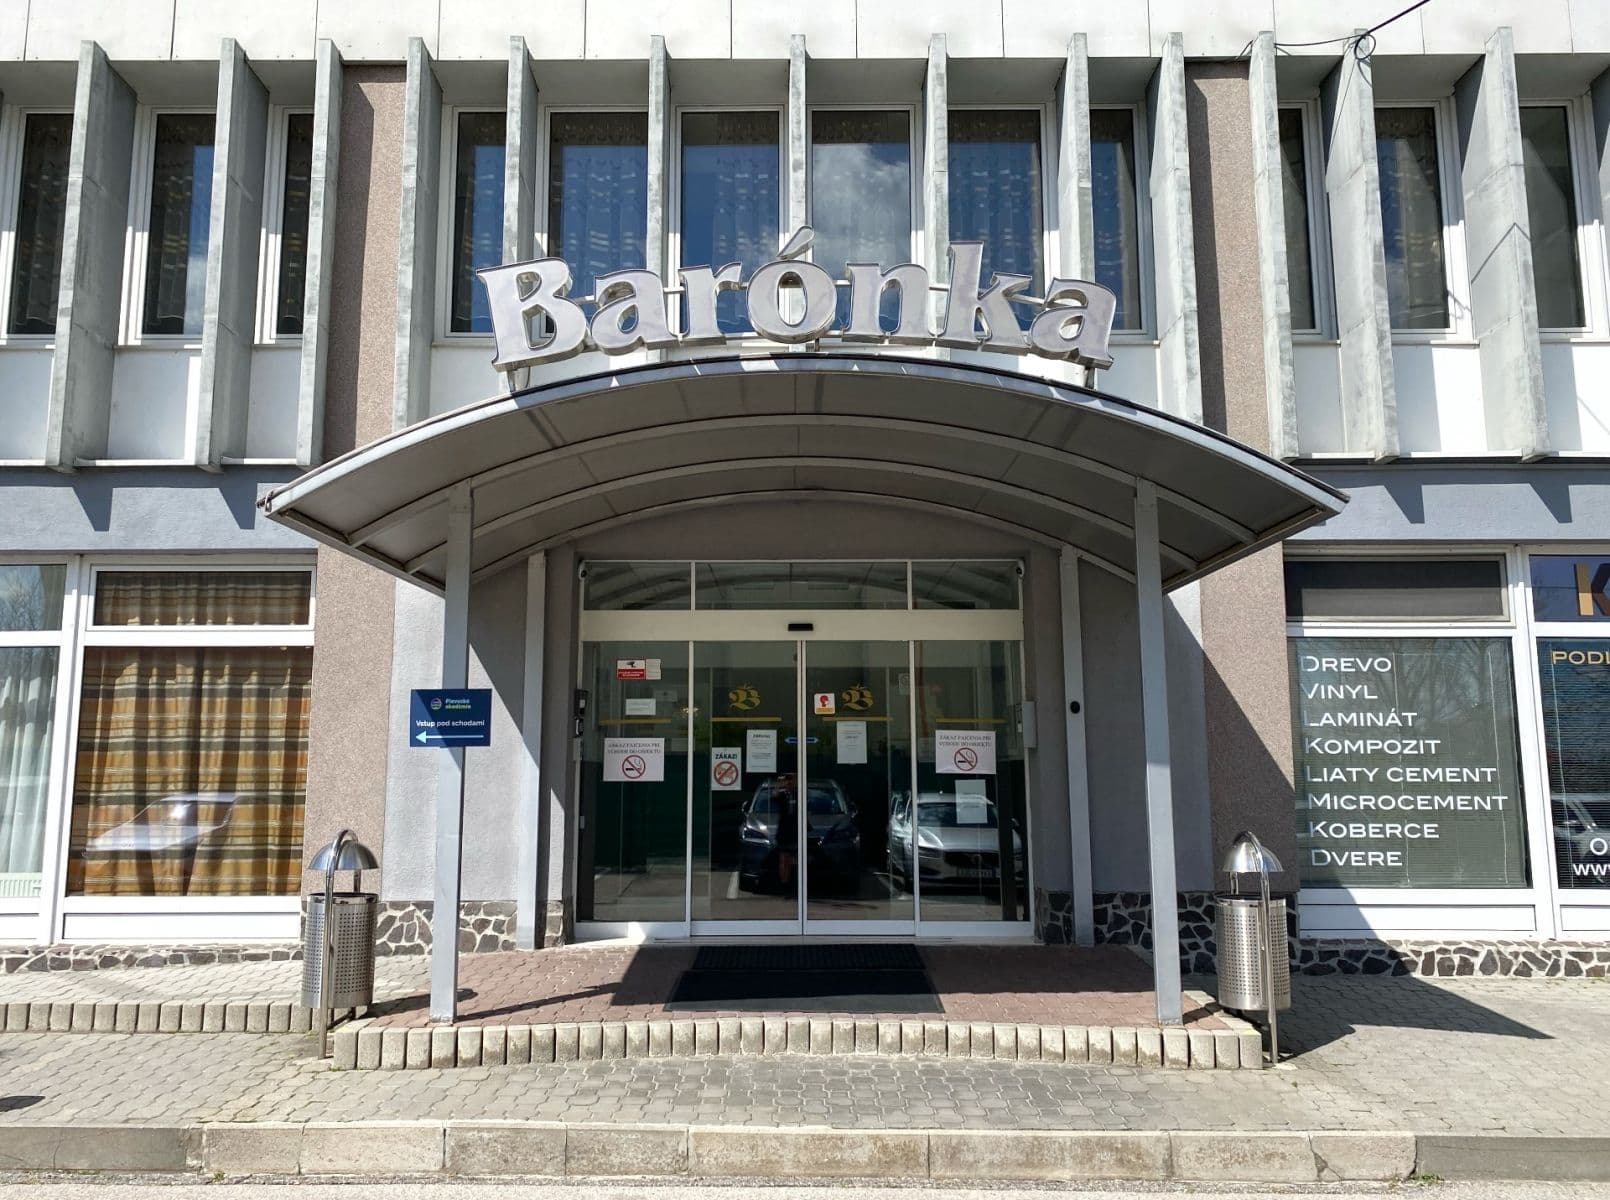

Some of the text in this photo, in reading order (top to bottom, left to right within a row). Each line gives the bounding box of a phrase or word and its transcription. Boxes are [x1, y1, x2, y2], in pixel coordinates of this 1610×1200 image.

[476, 226, 1118, 370] Barónka
[1301, 656, 1392, 672] DREVO
[1301, 683, 1378, 699] VINYL
[415, 719, 485, 728] Vstup pod schodami
[1303, 708, 1418, 727] LAMINÁT
[1305, 738, 1441, 755] KOMPOZIT
[1306, 765, 1497, 782] LIATY CEMENT
[1308, 793, 1508, 810] MICROCEMENT
[1309, 821, 1440, 838] KOBERCE
[1311, 850, 1403, 866] DVERE
